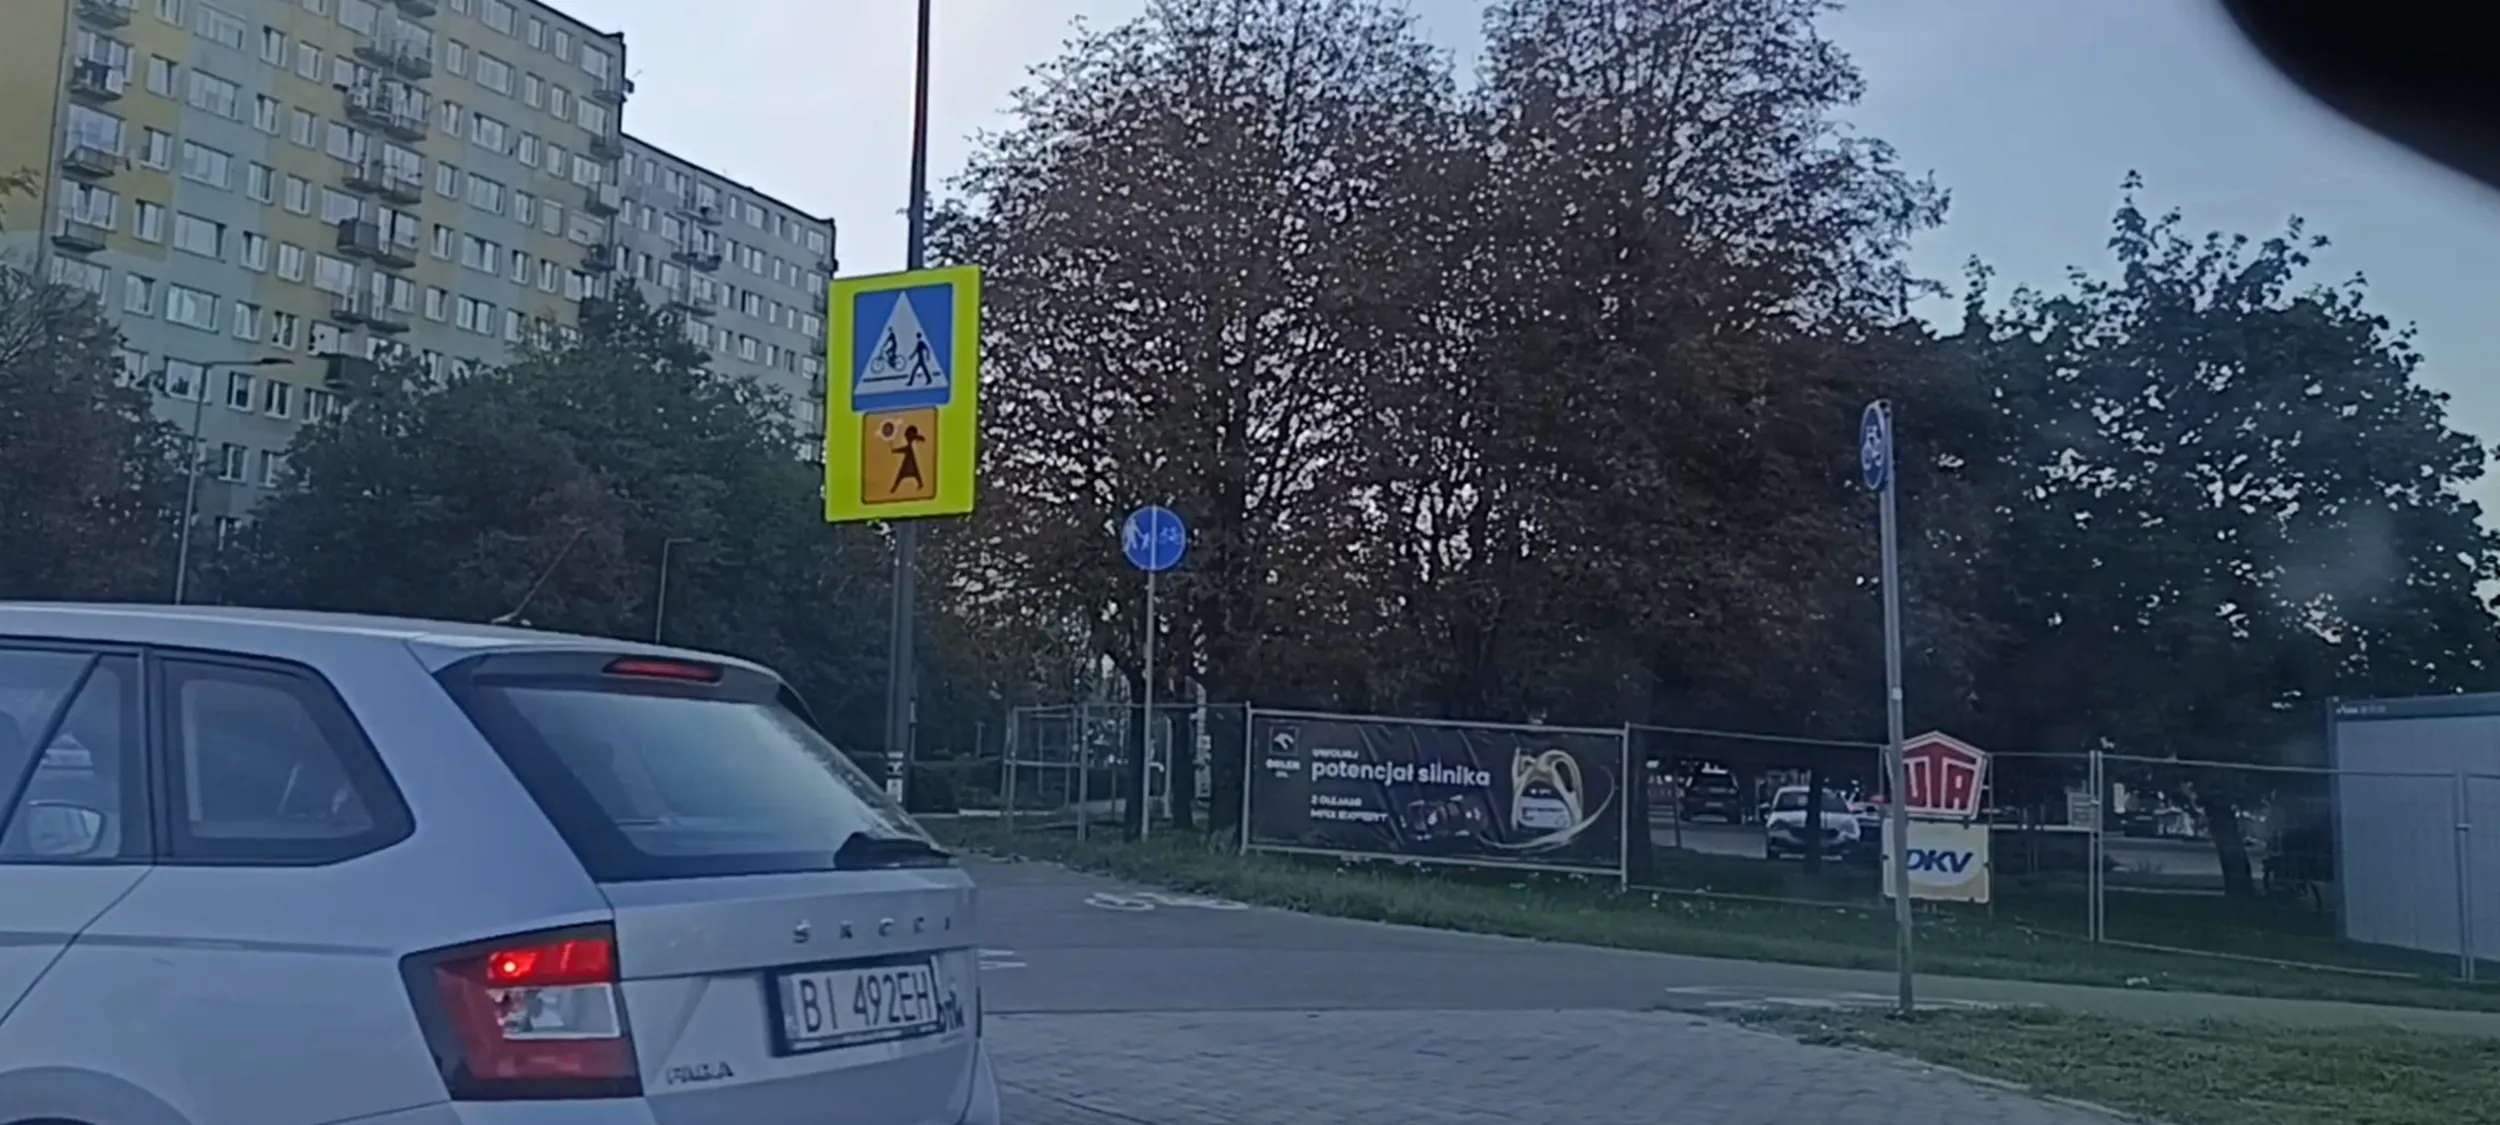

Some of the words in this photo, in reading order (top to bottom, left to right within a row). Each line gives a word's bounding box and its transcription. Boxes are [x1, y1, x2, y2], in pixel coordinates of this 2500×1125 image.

[1311, 760, 1414, 787] potencjał
[1417, 756, 1491, 786] silnika
[1906, 849, 1973, 873] DKV
[799, 977, 838, 1033] BI
[853, 971, 932, 1027] 492EH
